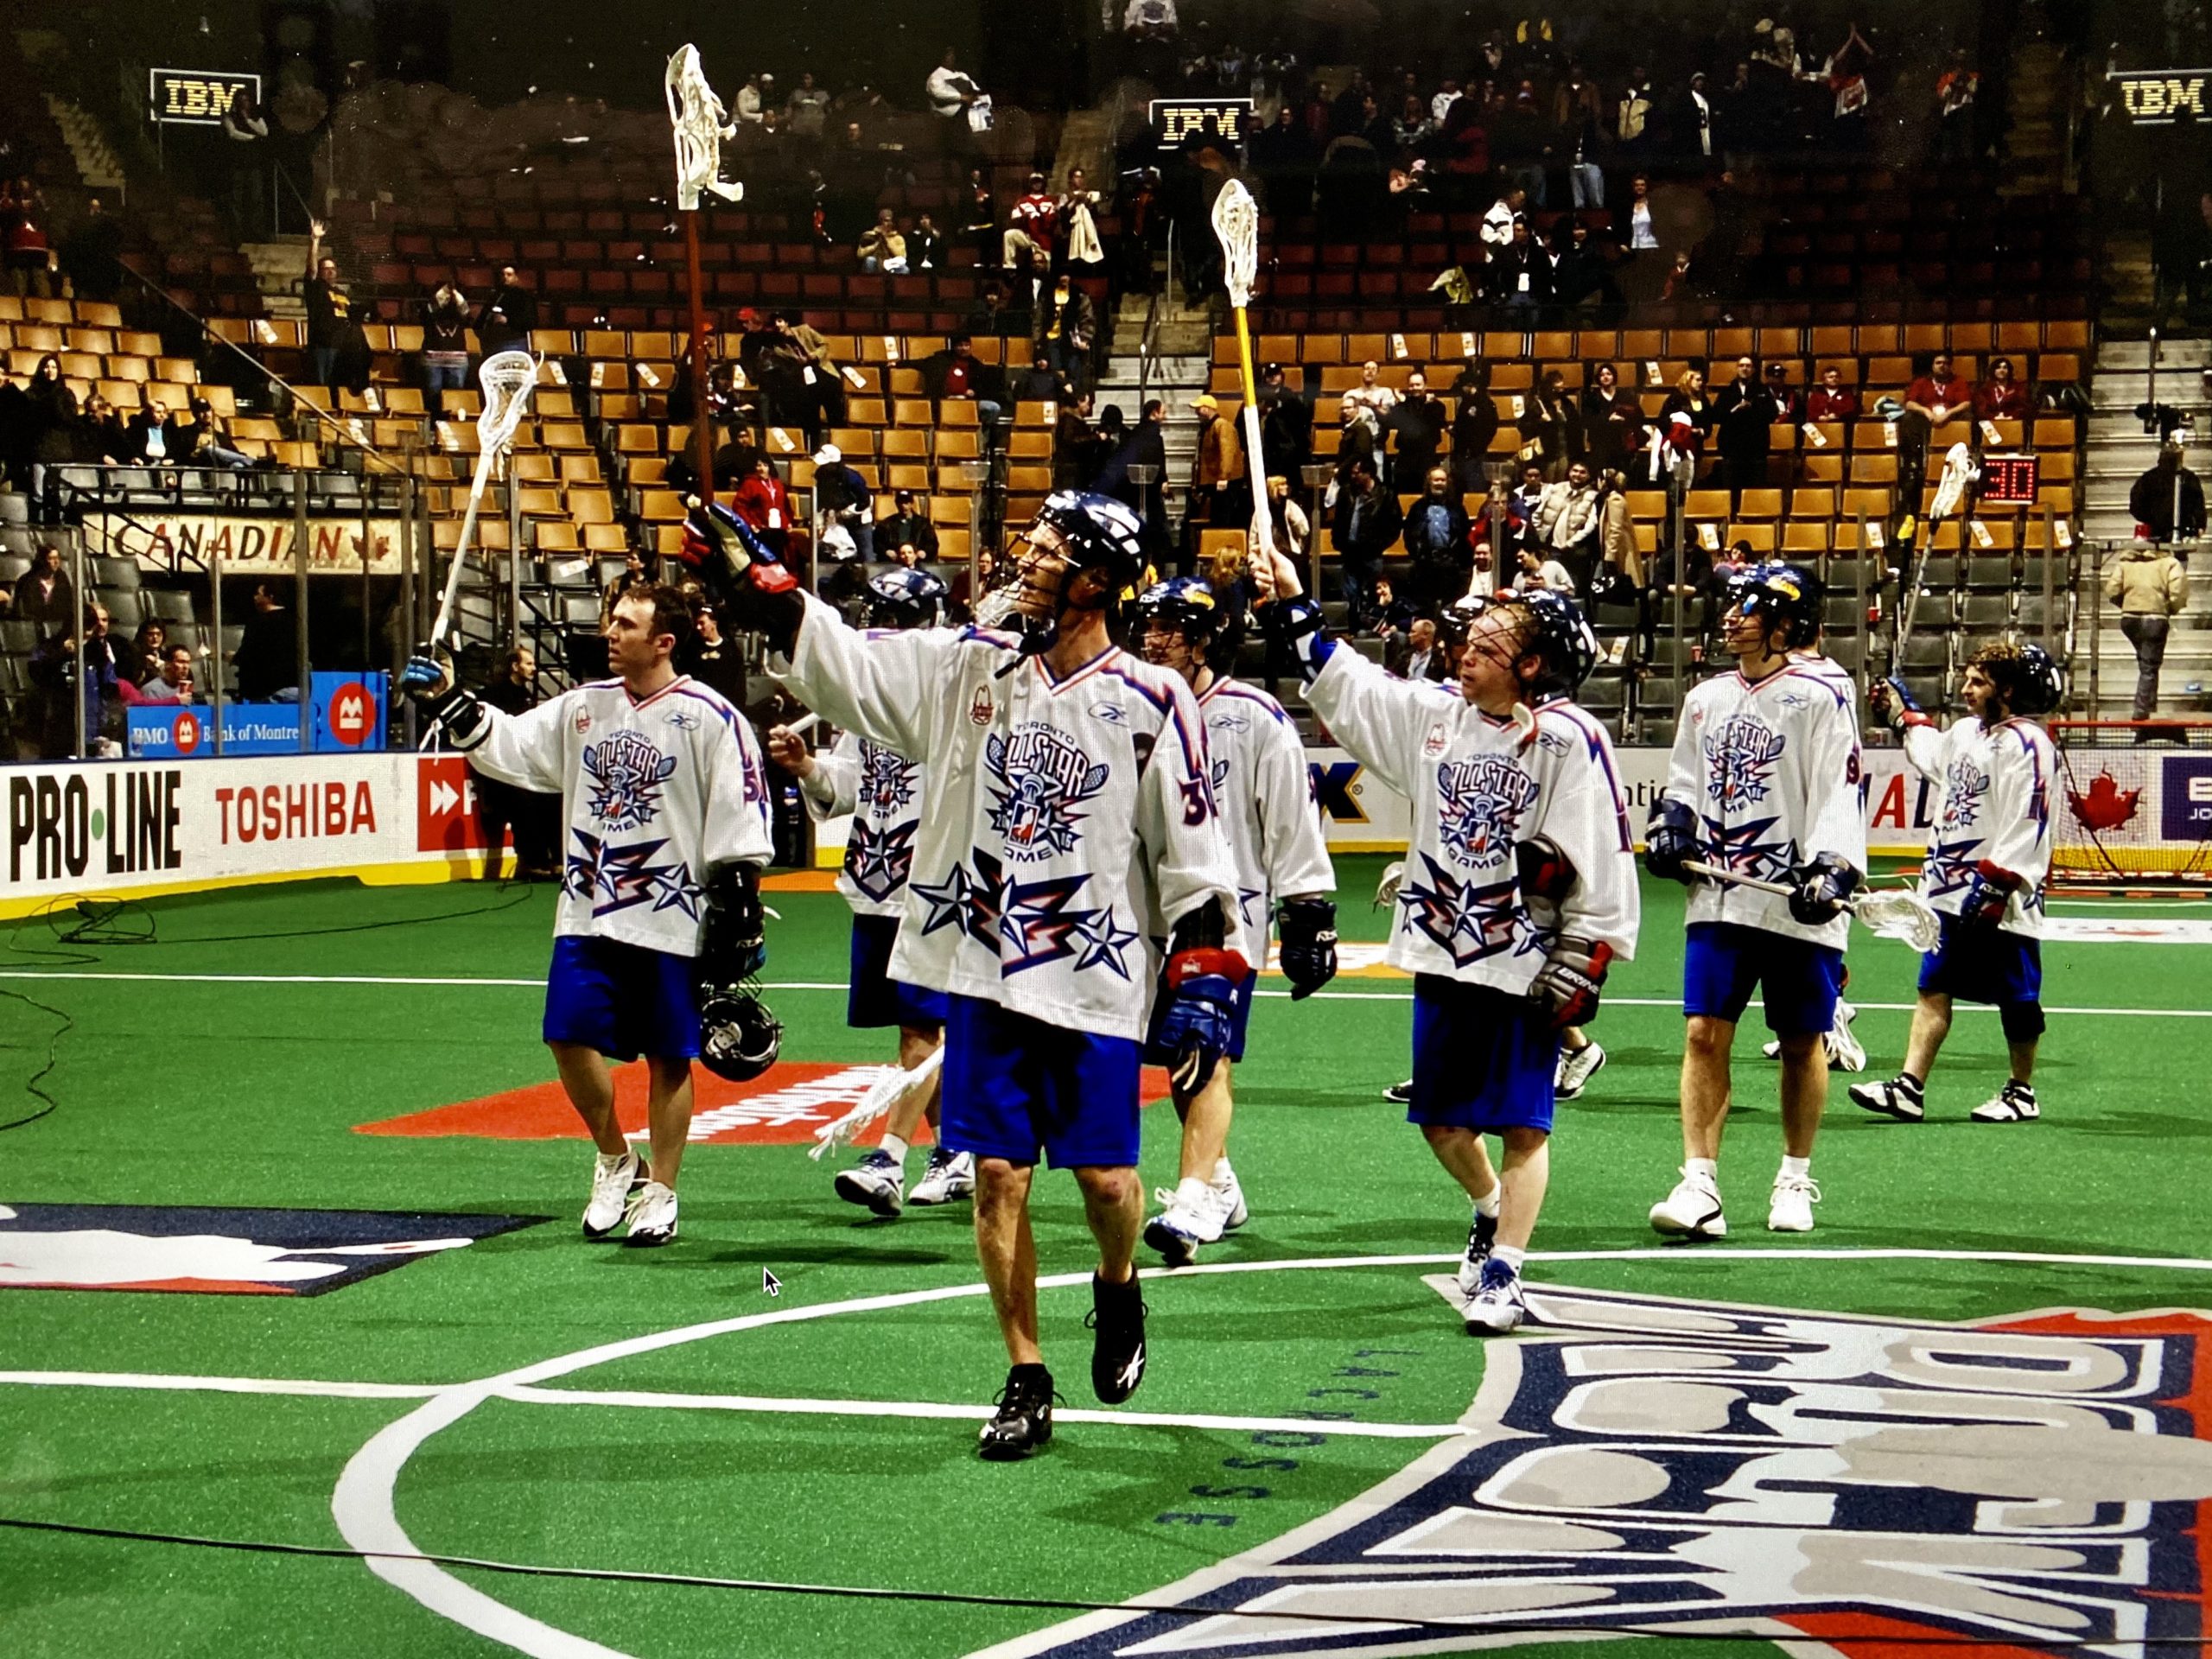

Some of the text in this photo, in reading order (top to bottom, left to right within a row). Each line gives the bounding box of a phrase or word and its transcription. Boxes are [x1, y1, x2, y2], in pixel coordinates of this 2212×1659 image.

[164, 79, 245, 116] IBM
[2120, 78, 2205, 115] IBM
[1984, 461, 2034, 499] 30
[203, 724, 236, 743] Bnk
[238, 724, 252, 741] of
[254, 722, 300, 741] Montre
[105, 770, 181, 874] LINE
[215, 780, 377, 845] TOSHIBA
[1447, 847, 1505, 870] GAME
[1154, 1348, 1422, 1530] LACROSSE
